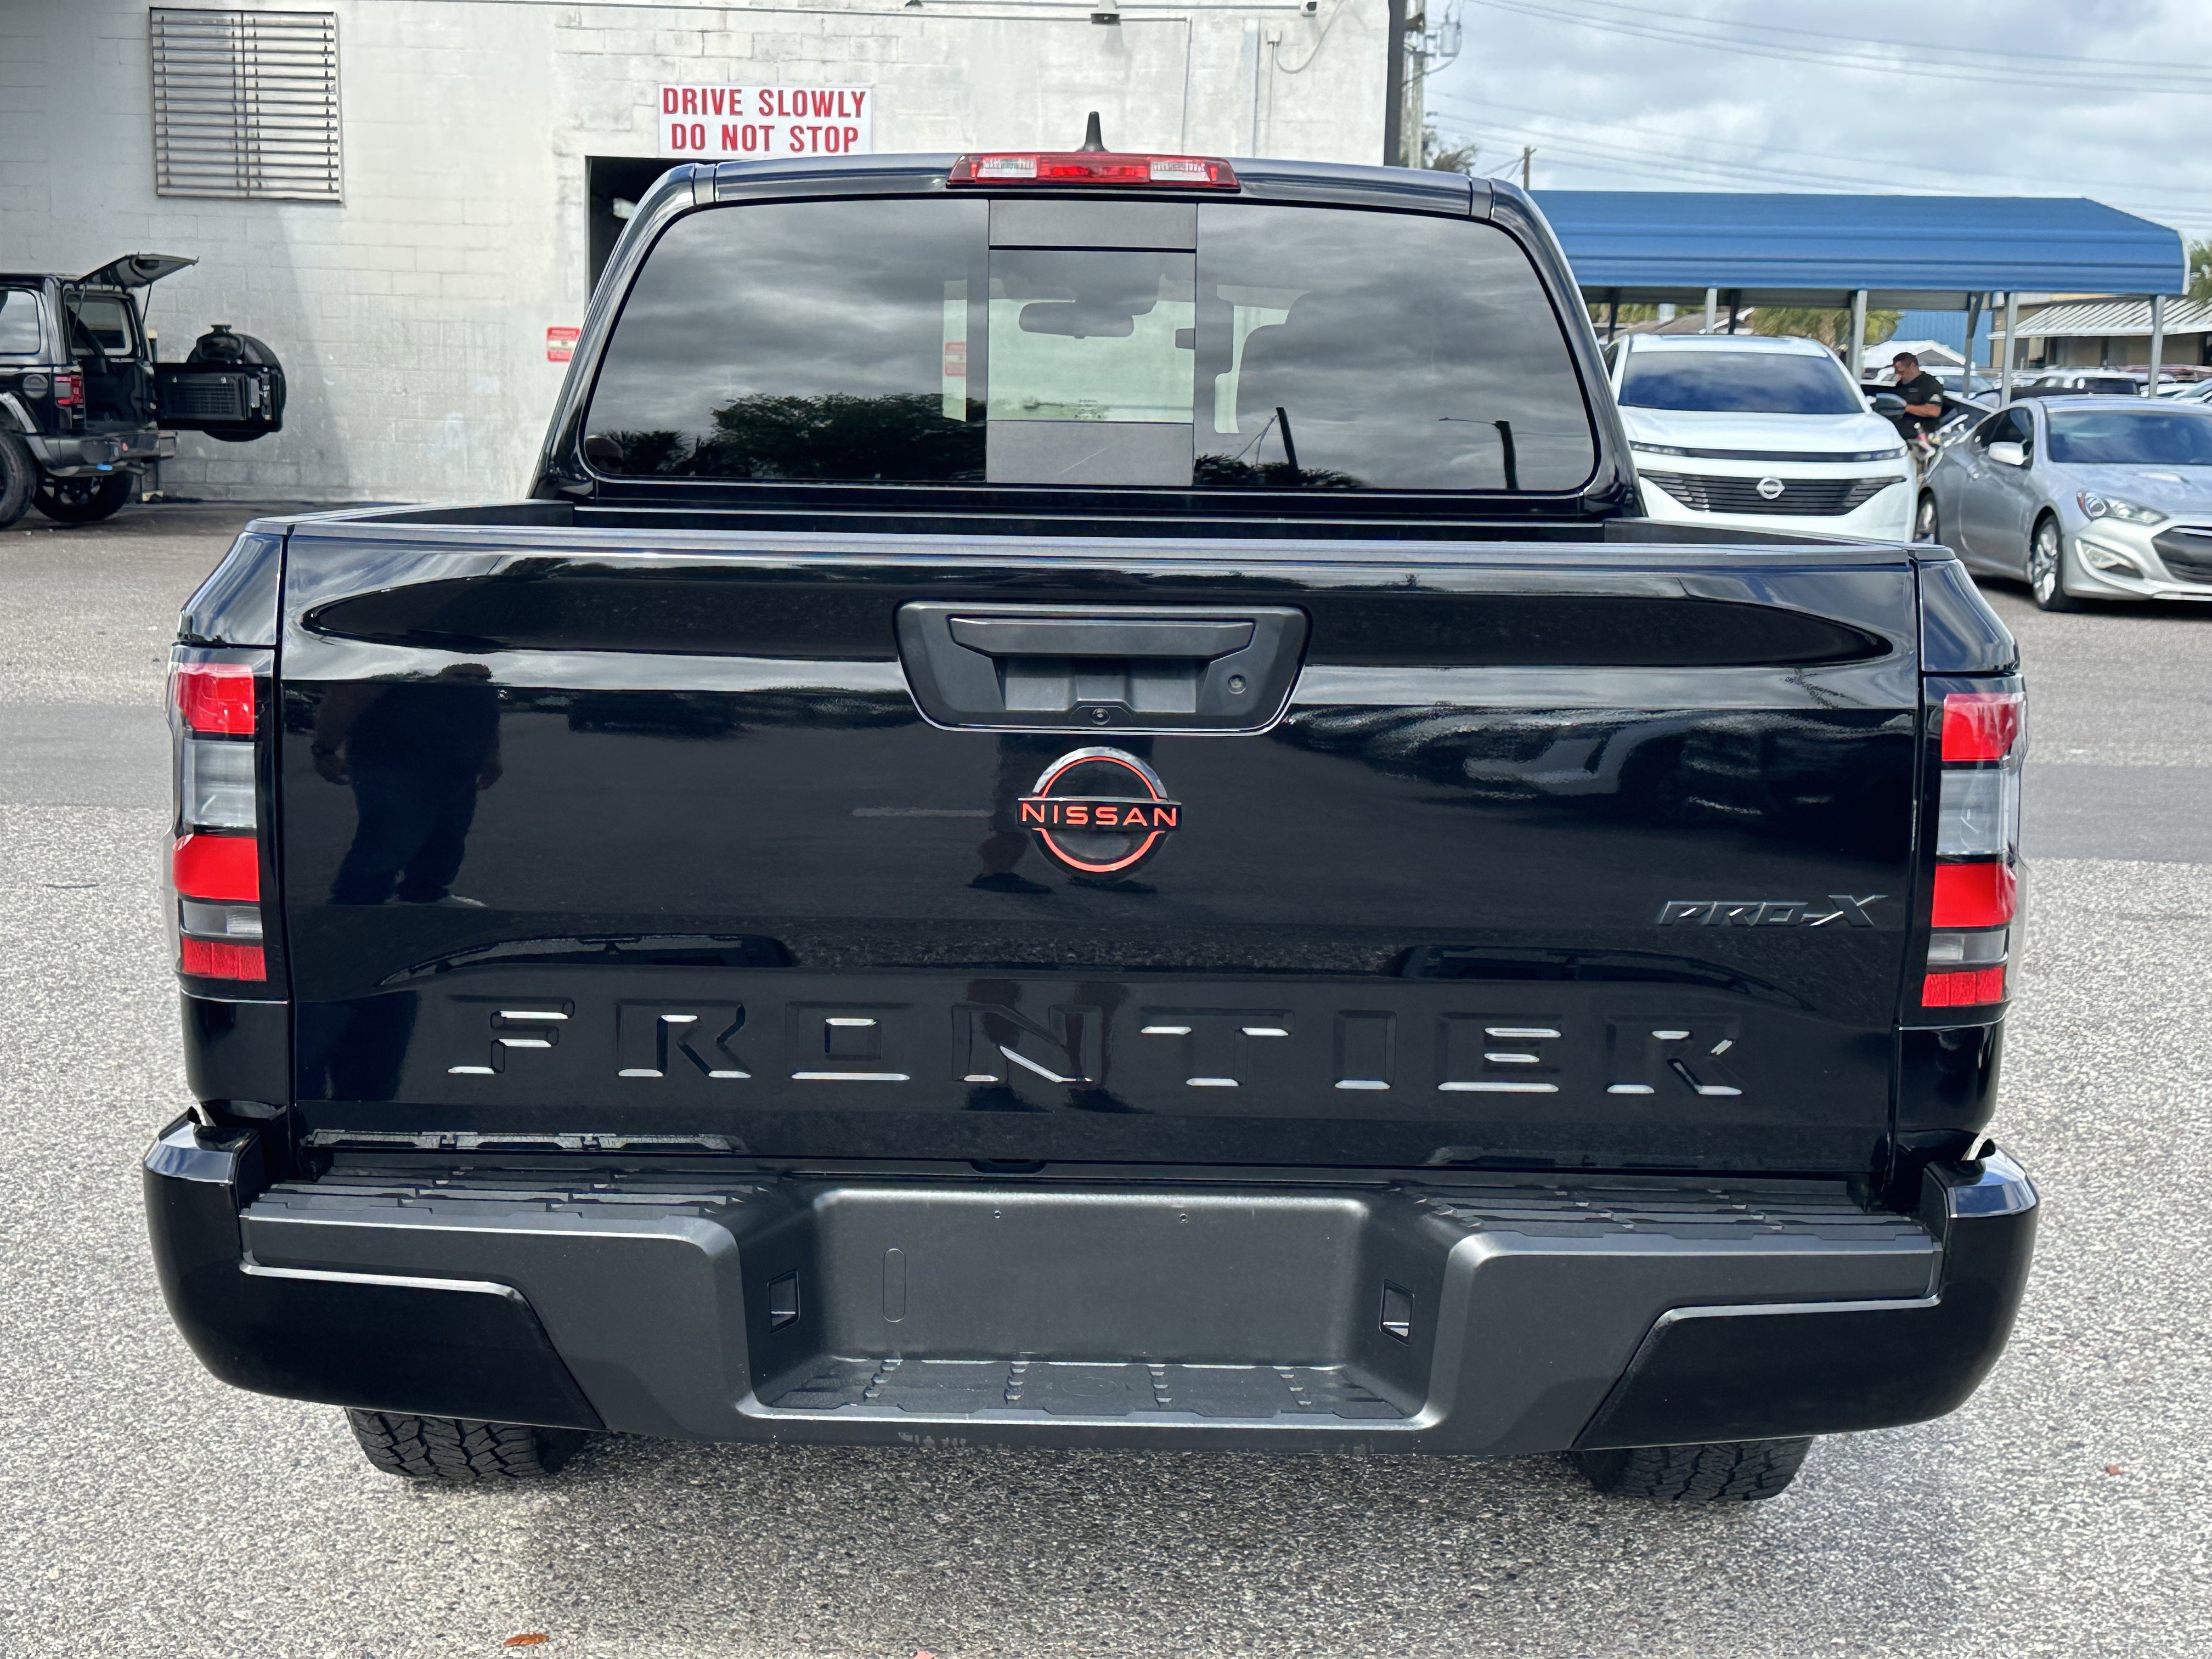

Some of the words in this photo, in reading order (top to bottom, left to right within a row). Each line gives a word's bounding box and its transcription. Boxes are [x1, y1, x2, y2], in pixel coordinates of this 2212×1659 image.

[663, 87, 743, 116] DRIVE
[758, 88, 866, 118] SLOWLY
[671, 123, 706, 150] DO
[721, 124, 775, 151] NOT
[789, 125, 859, 153] STOP
[1021, 803, 1177, 827] NISSAN
[1657, 894, 1889, 928] PRO-X
[443, 994, 1747, 1097] FRONTIER
